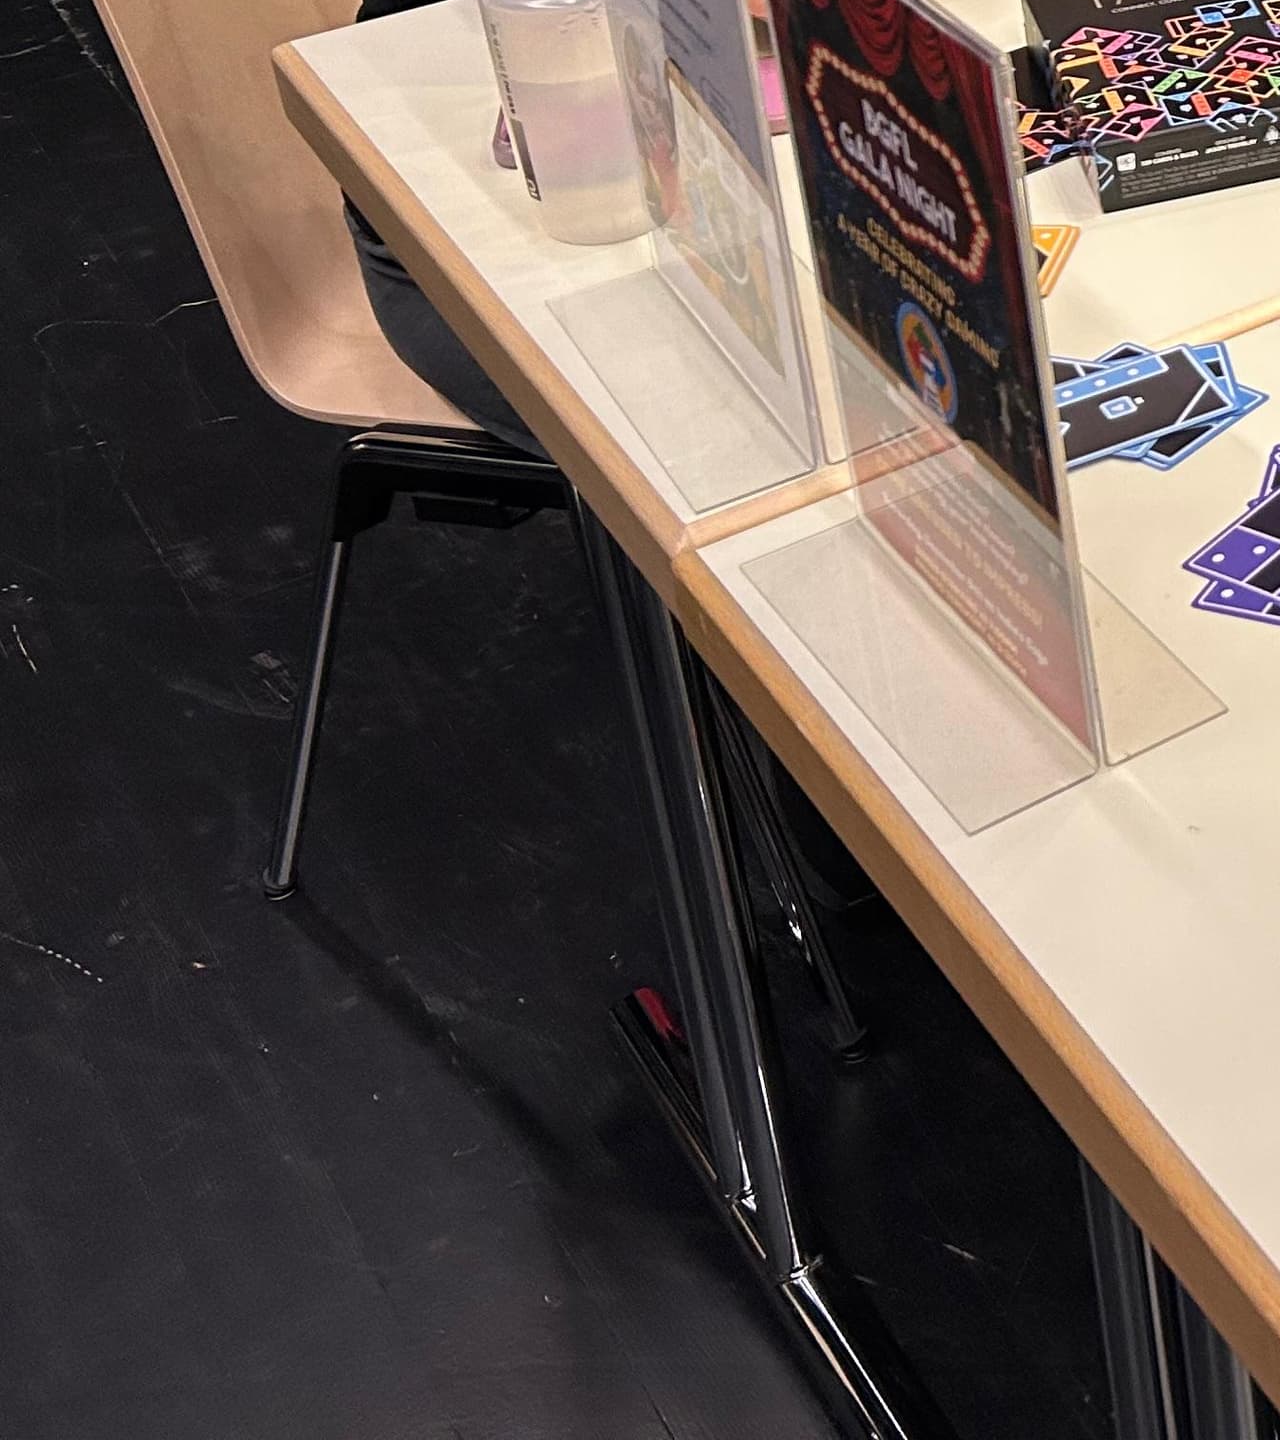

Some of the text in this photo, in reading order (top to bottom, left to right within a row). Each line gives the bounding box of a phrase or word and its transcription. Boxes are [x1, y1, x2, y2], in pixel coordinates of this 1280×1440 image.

[861, 98, 918, 172] BGFL
[839, 121, 957, 242] GALA NIGHT
[866, 217, 956, 306] CELEBRATING
